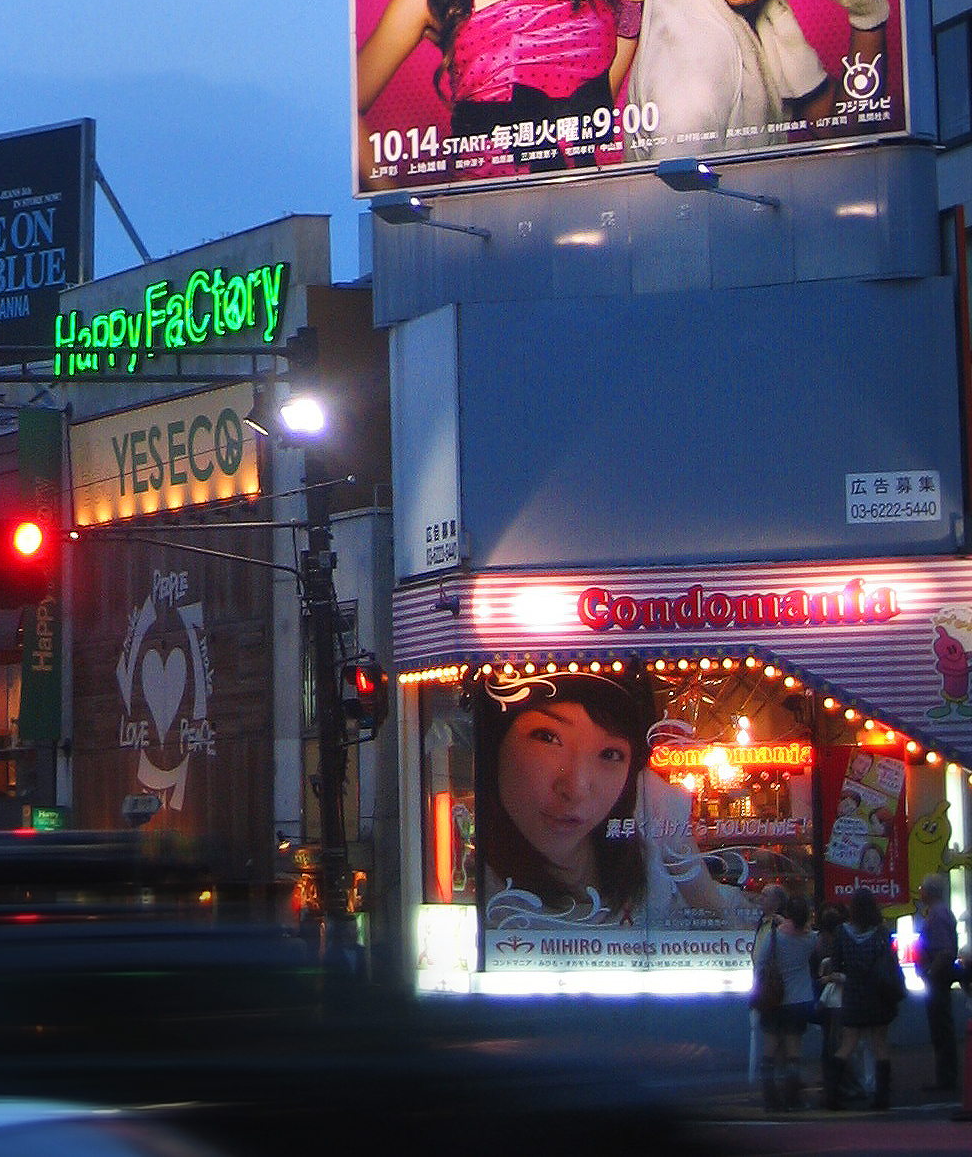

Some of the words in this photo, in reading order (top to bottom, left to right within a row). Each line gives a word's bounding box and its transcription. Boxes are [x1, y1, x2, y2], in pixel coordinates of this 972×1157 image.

[834, 95, 892, 114] フジテレビ
[368, 125, 440, 163] 10.14
[491, 116, 579, 151] 毎週火曜
[592, 101, 660, 138] 9:00
[10, 207, 56, 249] ON
[850, 474, 935, 495] 広告募集
[850, 501, 937, 519] 03-6222-5440
[576, 577, 902, 631] Condomania
[119, 714, 150, 750] LOVE
[650, 740, 814, 768] Conomania
[714, 817, 768, 837] TOUCH
[540, 938, 603, 956] MIHIRO
[607, 939, 657, 956] meets
[660, 937, 729, 955] notouch
